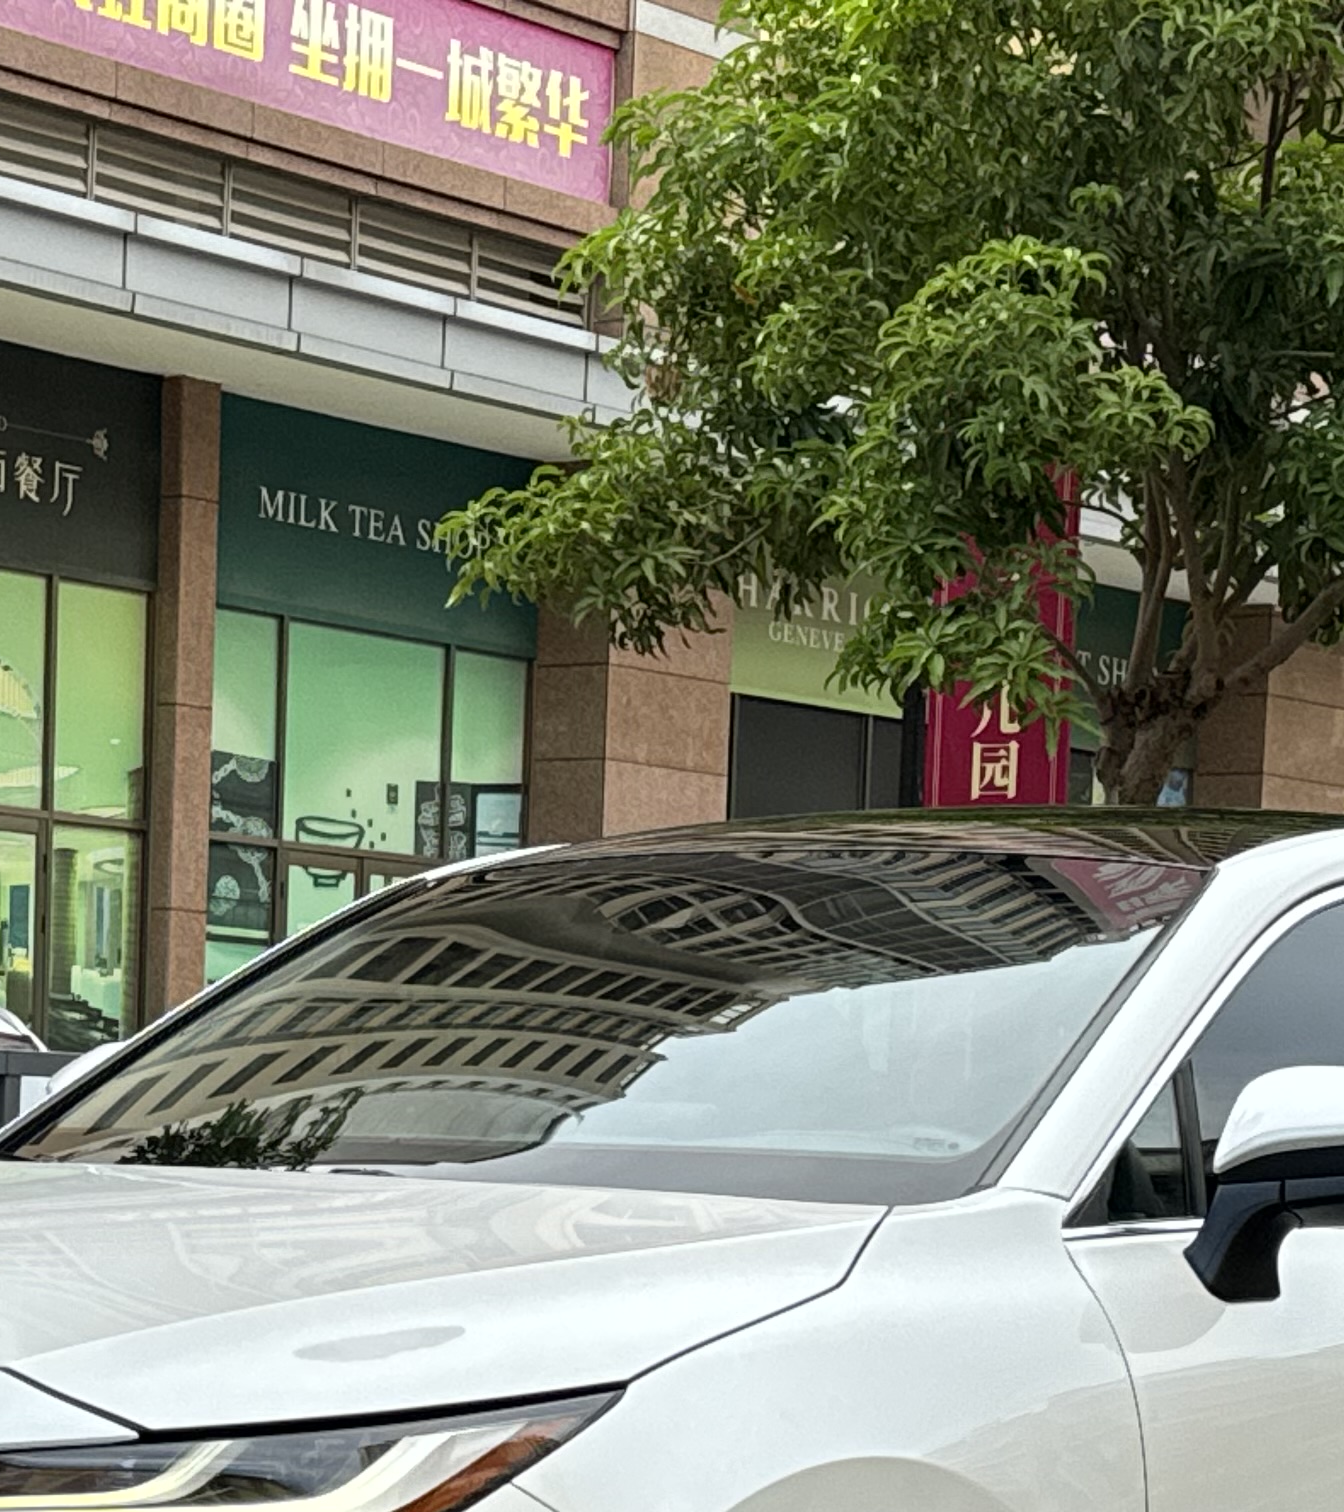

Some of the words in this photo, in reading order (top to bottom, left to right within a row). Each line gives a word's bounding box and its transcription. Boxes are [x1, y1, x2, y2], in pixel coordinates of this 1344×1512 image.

[288, 0, 590, 158] 坐拥一城繁华
[258, 486, 339, 533] MILK
[348, 504, 406, 546] TEA
